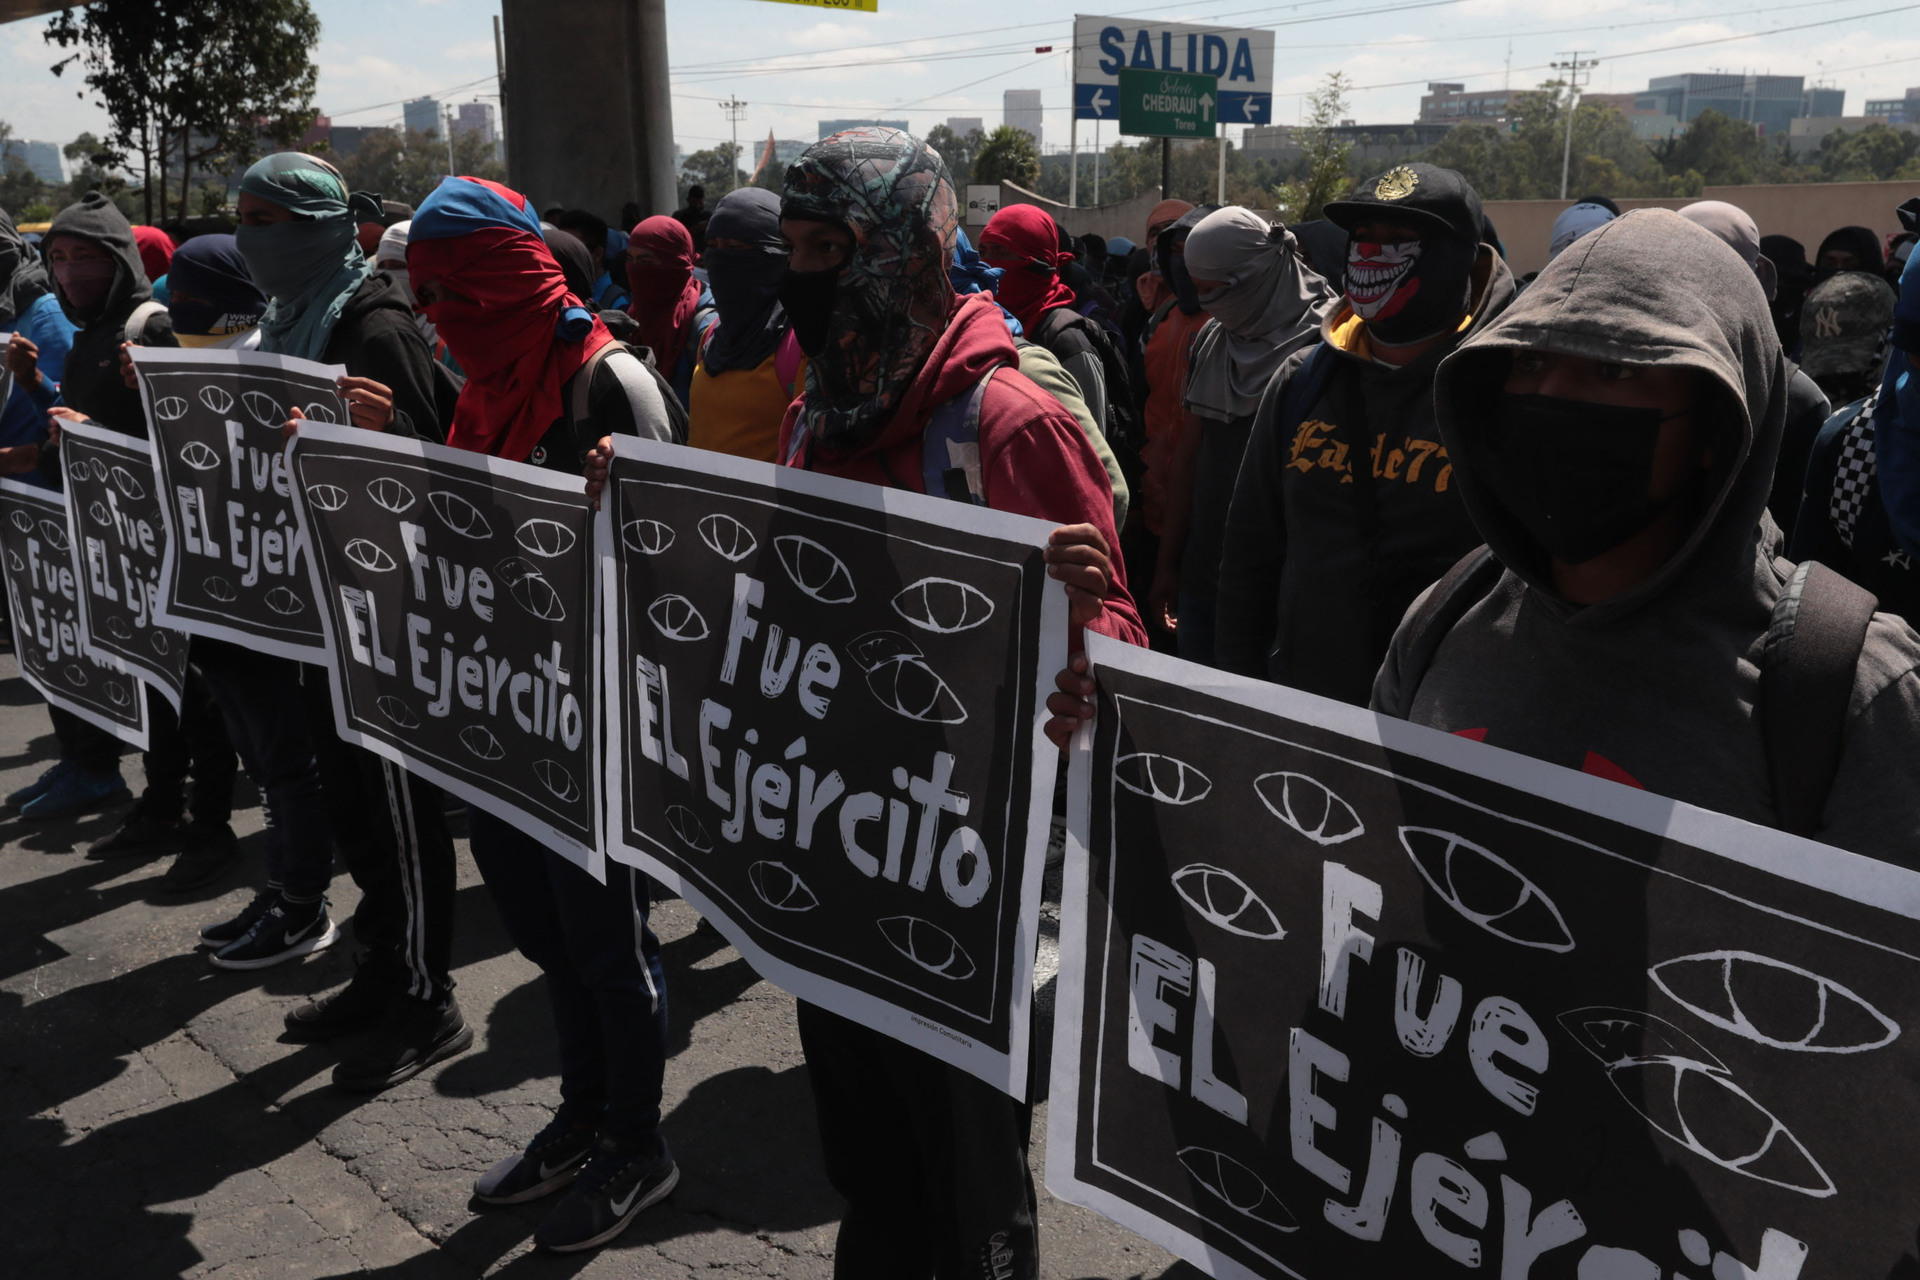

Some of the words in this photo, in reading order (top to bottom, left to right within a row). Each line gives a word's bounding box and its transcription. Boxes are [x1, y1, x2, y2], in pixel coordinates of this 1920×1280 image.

[1099, 26, 1256, 82] SALIDA
[1174, 118, 1196, 130] Toreo
[225, 419, 291, 498] Fue
[106, 487, 157, 557] Fue
[177, 485, 221, 559] EL
[27, 537, 75, 601] Fue
[86, 536, 118, 601] EL
[400, 521, 495, 622] Fue
[339, 584, 397, 676] EL
[720, 573, 840, 720] Fue
[407, 612, 583, 751] Ejército
[636, 654, 690, 782] EL
[700, 698, 991, 908] Ejército
[1128, 933, 1248, 1126] EL
[1319, 860, 1549, 1116] Fue
